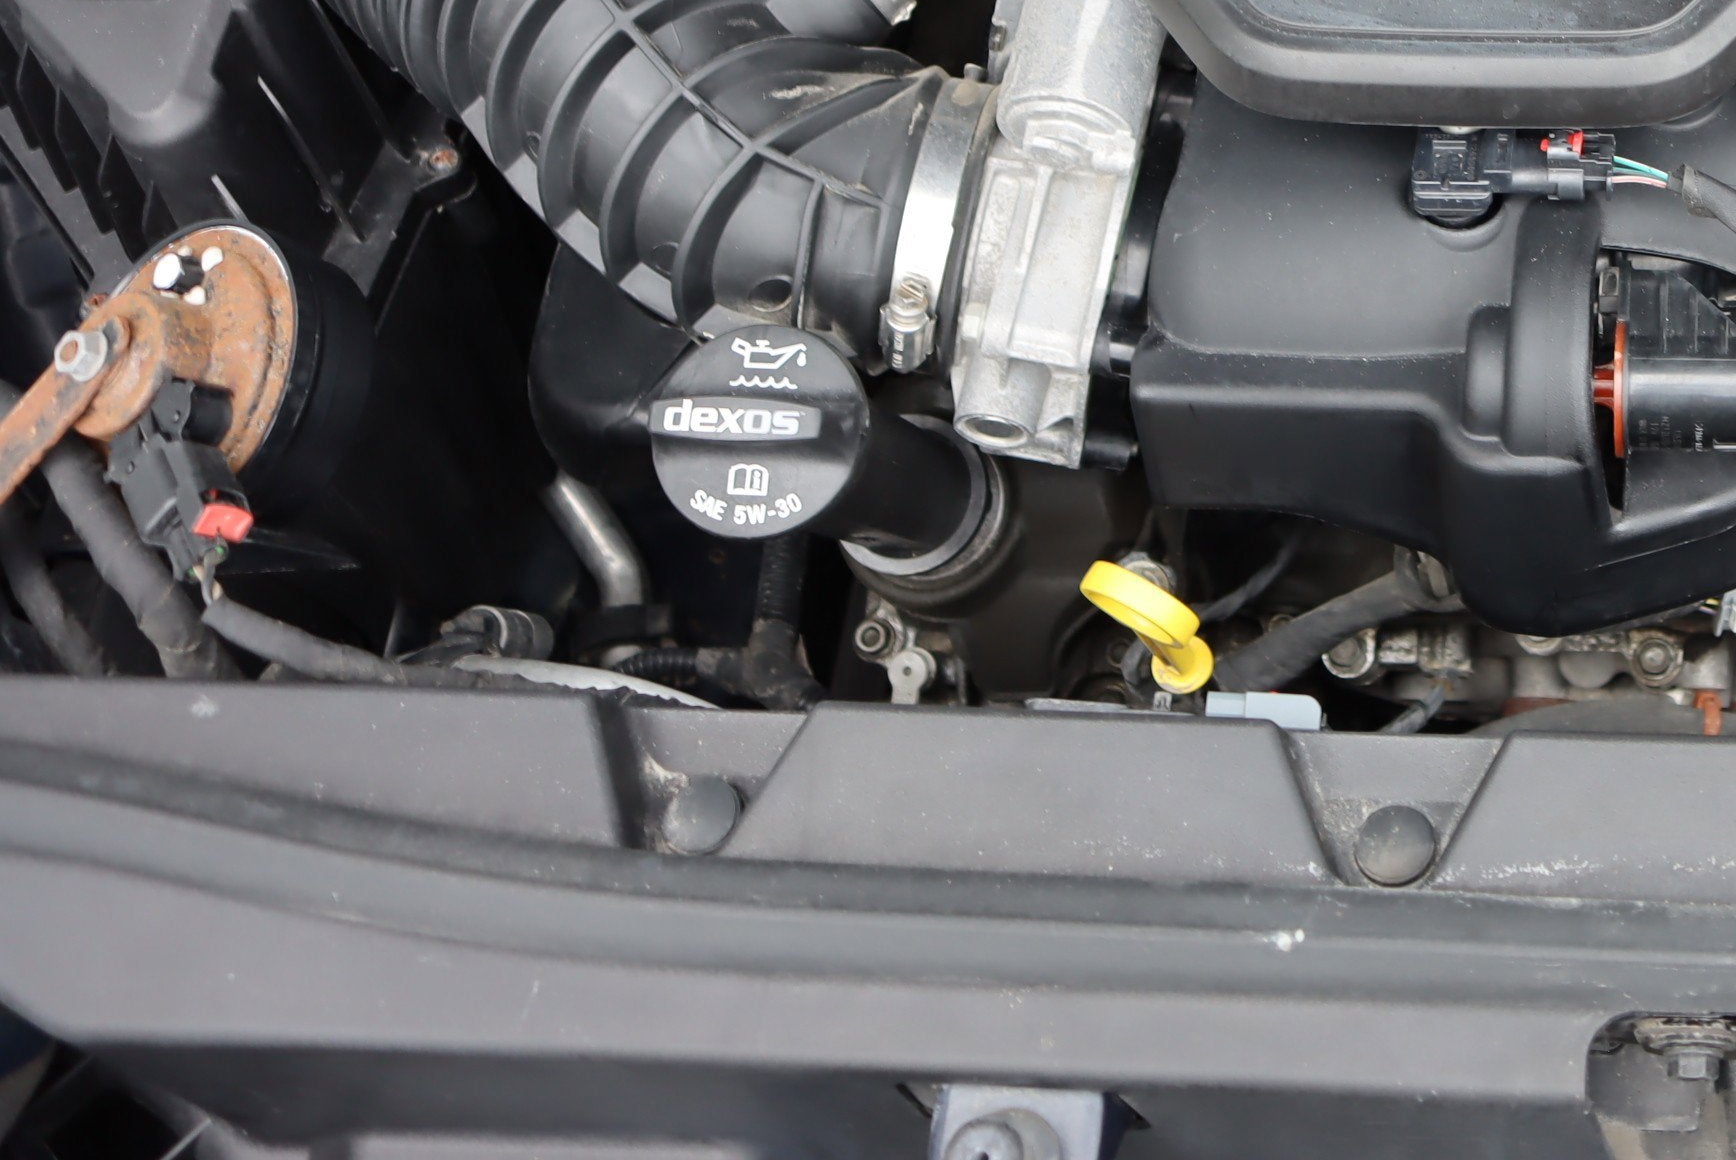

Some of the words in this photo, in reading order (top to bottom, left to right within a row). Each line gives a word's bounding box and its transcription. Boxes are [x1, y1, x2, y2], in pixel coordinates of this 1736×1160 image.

[663, 398, 802, 436] dexos
[689, 489, 728, 522] SAE
[733, 492, 803, 525] 5W-30
